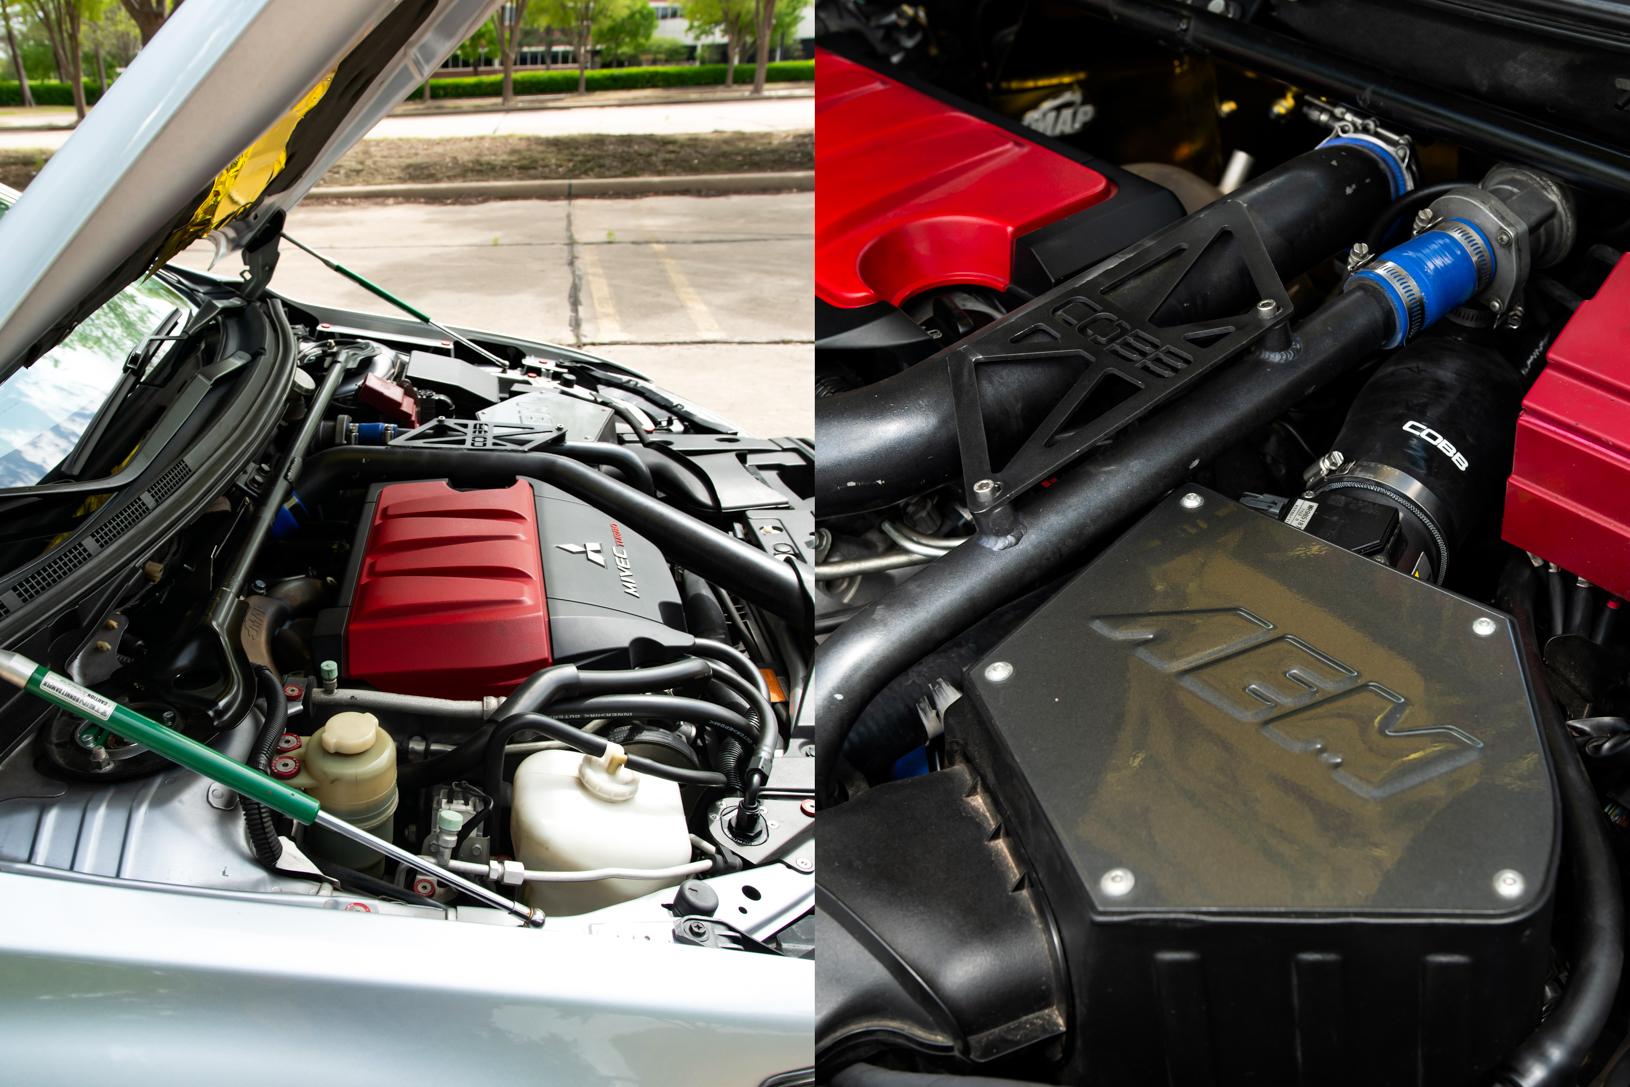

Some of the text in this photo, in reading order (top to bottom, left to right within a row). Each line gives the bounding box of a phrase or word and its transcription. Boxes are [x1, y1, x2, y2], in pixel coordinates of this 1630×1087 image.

[1052, 296, 1193, 378] COBB
[1402, 420, 1469, 471] COBB
[612, 546, 640, 599] MIVEC
[87, 693, 108, 706] CAUTION
[1089, 607, 1484, 798] AEM
